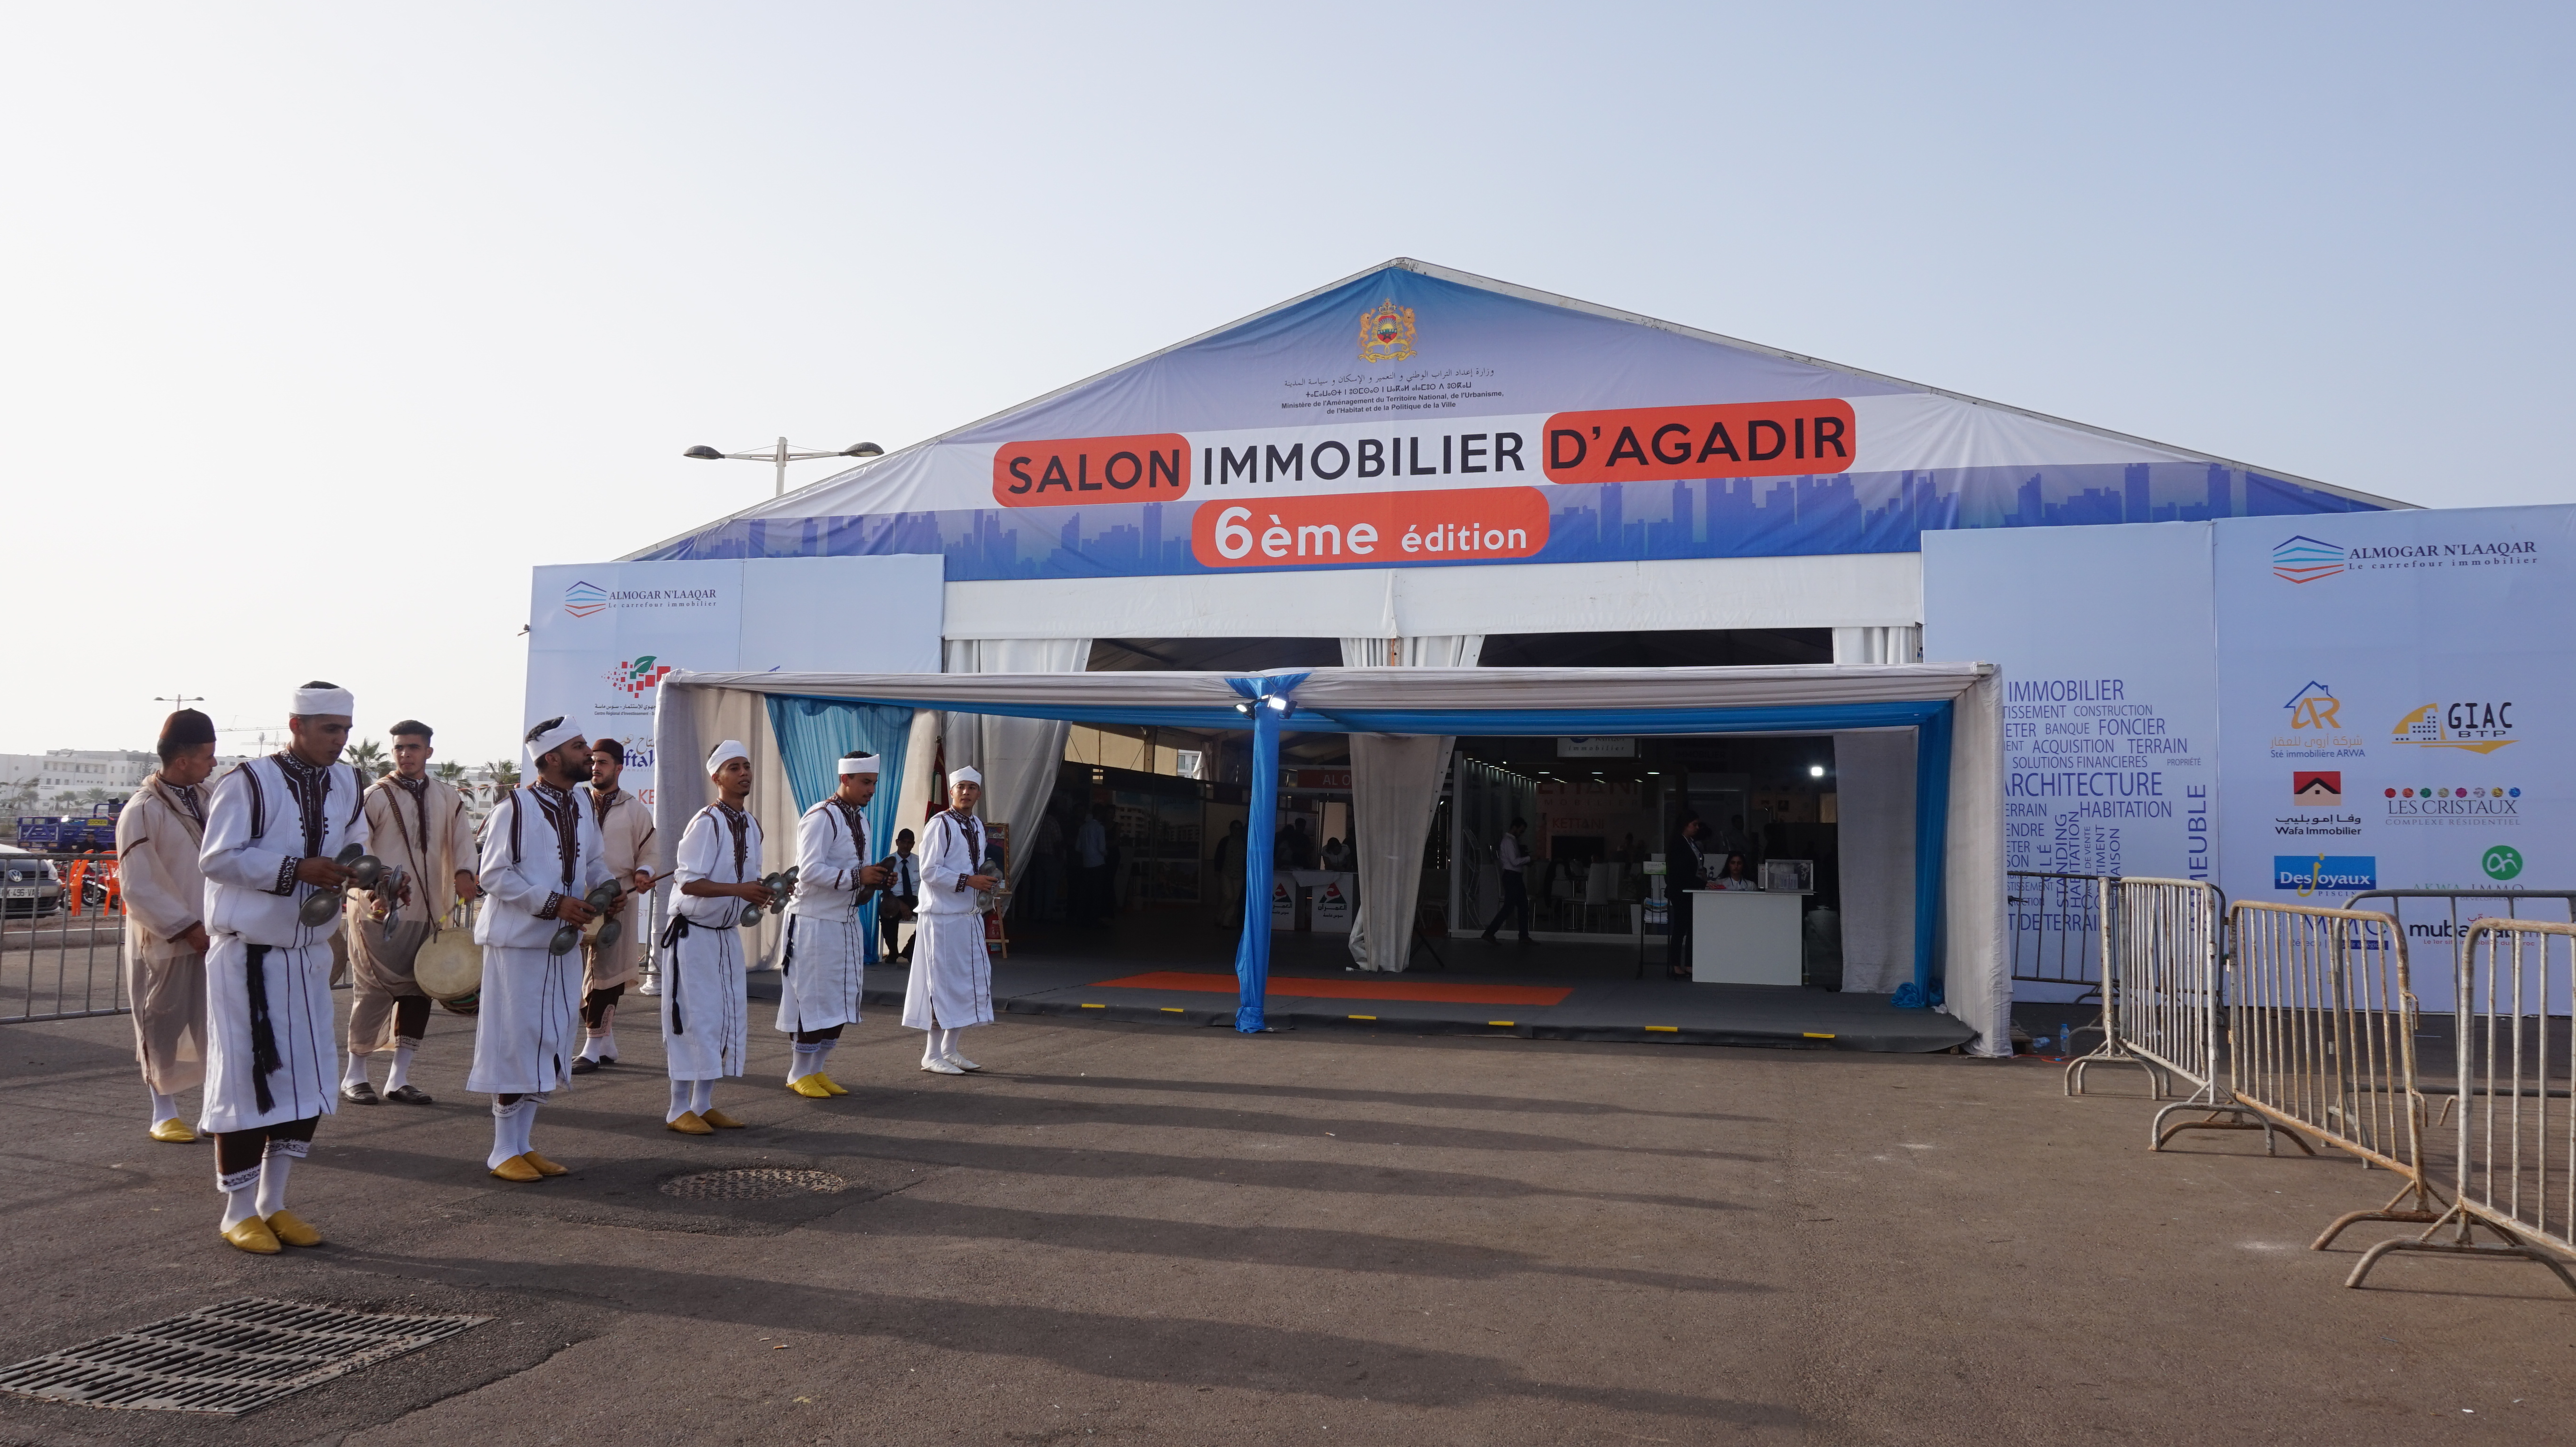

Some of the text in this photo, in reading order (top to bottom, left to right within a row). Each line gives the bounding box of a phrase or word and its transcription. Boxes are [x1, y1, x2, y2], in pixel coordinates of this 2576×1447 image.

[1375, 372, 1395, 383] التعمير
[1407, 370, 1428, 382] الوطني
[1432, 369, 1452, 379] التراب
[1455, 368, 1473, 377] إعداد
[1476, 368, 1494, 377] وزارة
[1285, 378, 1305, 387] المدينة
[1338, 374, 1364, 384] الإسكان
[1323, 398, 1374, 407] l'Aménagement
[1386, 394, 1416, 402] Territoire
[1008, 417, 1847, 494] SALON IMMOBILIER D'AGADIR
[1215, 506, 1526, 560] 6ème édition
[2348, 541, 2537, 559] ALMOGAR N'LAAQAR
[2372, 560, 2443, 569] carrefour
[2452, 557, 2537, 567] immobilier
[609, 589, 716, 600] ALMOGAR N'LAAQAR
[2009, 680, 2124, 702] IMMOBILIER
[2074, 705, 2152, 716] CONSTRUCTION
[2448, 702, 2512, 729] GIAC
[2006, 718, 2166, 737] ETER BANQUE FONCIER
[2004, 738, 2187, 755] ENT ACQUISITION TERRAIN
[2333, 734, 2363, 748] شركة
[2271, 749, 2365, 758] Sté immobilière ARWA
[2013, 757, 2074, 769] SOLUTIONS
[2077, 756, 2148, 768] FINANCIERES
[1322, 775, 1338, 785] AL
[2080, 801, 2171, 817] HABITATION
[2388, 800, 2517, 814] LES CRISTAUX
[1552, 817, 1604, 829] KETTANI
[2275, 826, 2362, 835] Wafa Immobilier
[2055, 814, 2069, 908] STANDING
[2068, 811, 2081, 908] HABITATION
[2085, 860, 2092, 868] DE
[2187, 784, 2208, 932] EUBLE
